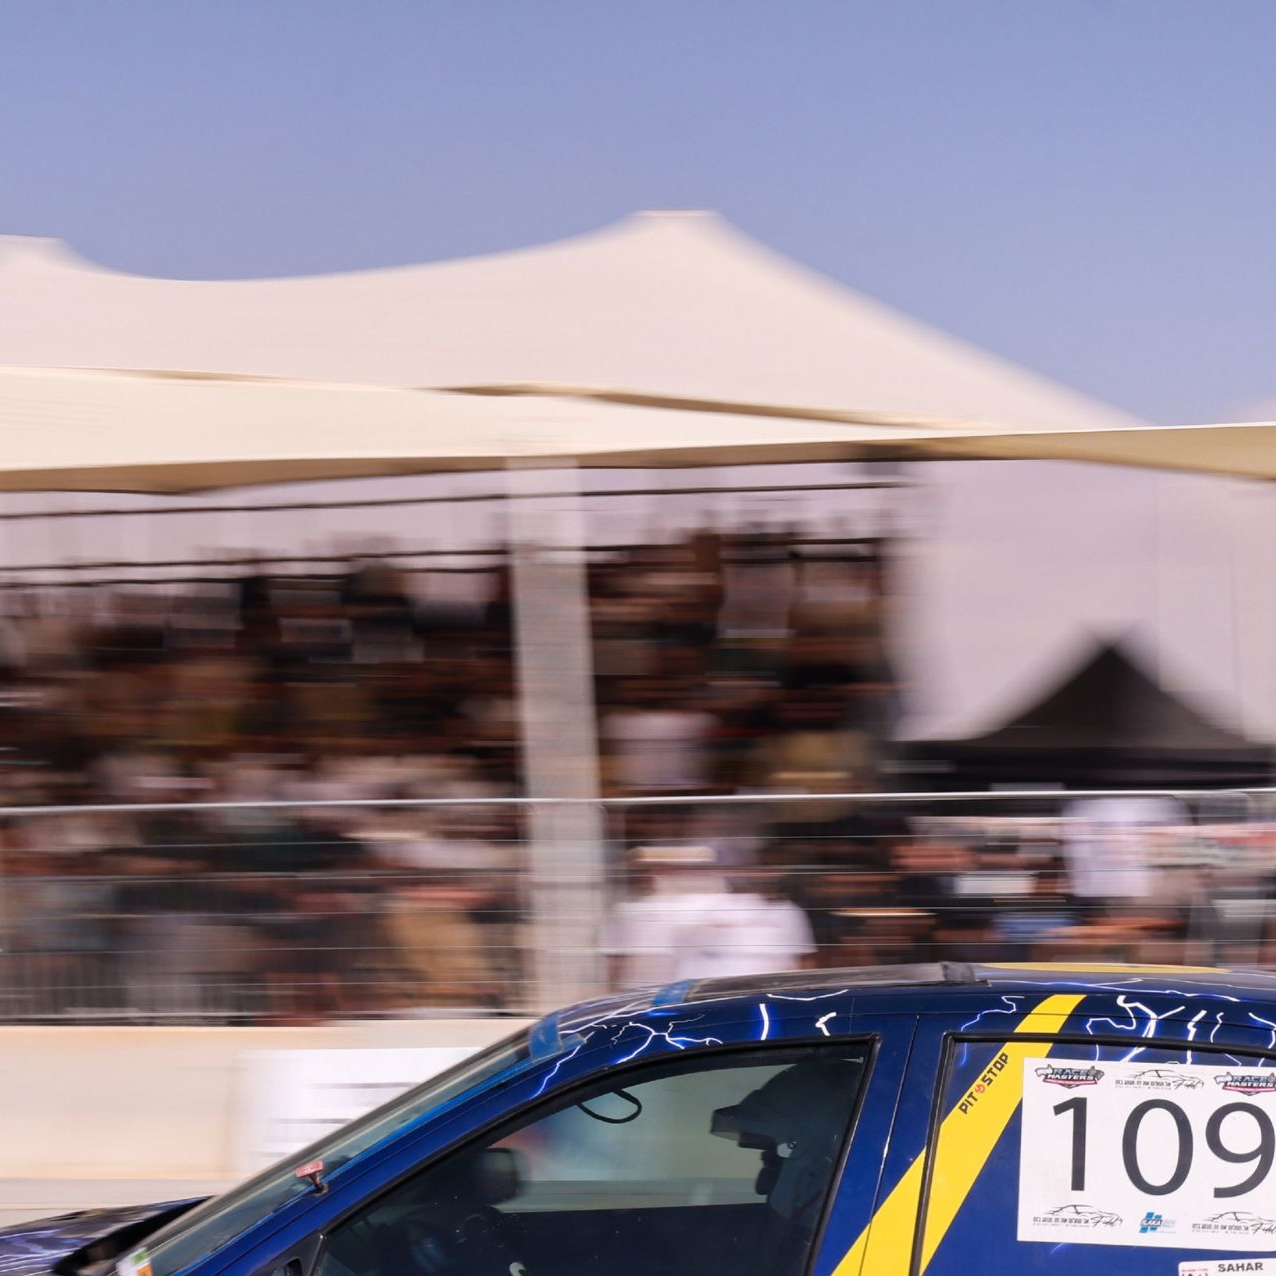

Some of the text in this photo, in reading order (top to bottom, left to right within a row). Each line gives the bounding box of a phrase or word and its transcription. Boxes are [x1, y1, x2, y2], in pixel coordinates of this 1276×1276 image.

[958, 1052, 1009, 1115] PIT STOP
[1052, 1096, 1276, 1199] 109
[1217, 1262, 1264, 1273] SAHAR
